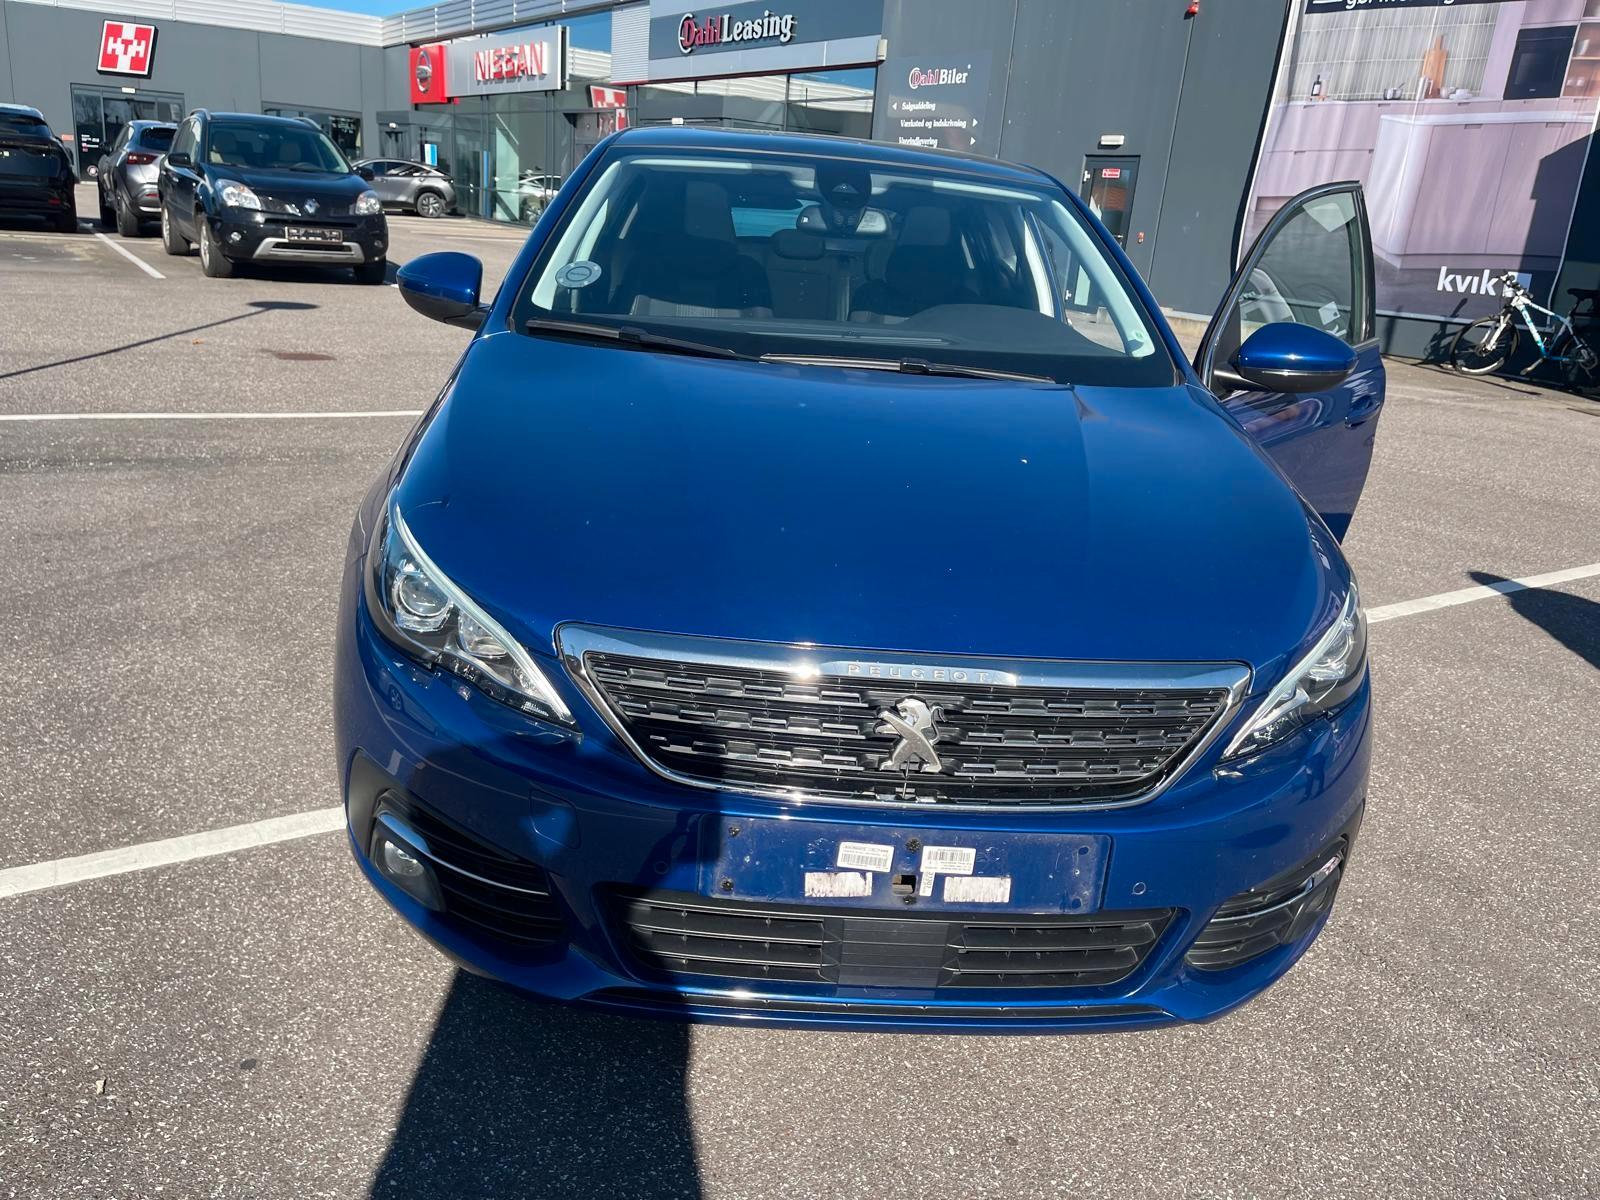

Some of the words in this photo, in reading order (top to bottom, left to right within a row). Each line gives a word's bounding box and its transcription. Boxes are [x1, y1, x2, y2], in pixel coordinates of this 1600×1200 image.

[107, 36, 146, 58] HTH
[474, 40, 549, 81] NISSAN
[925, 121, 932, 129] og
[1437, 265, 1499, 296] kvik
[847, 664, 989, 682] PEUGEOT
